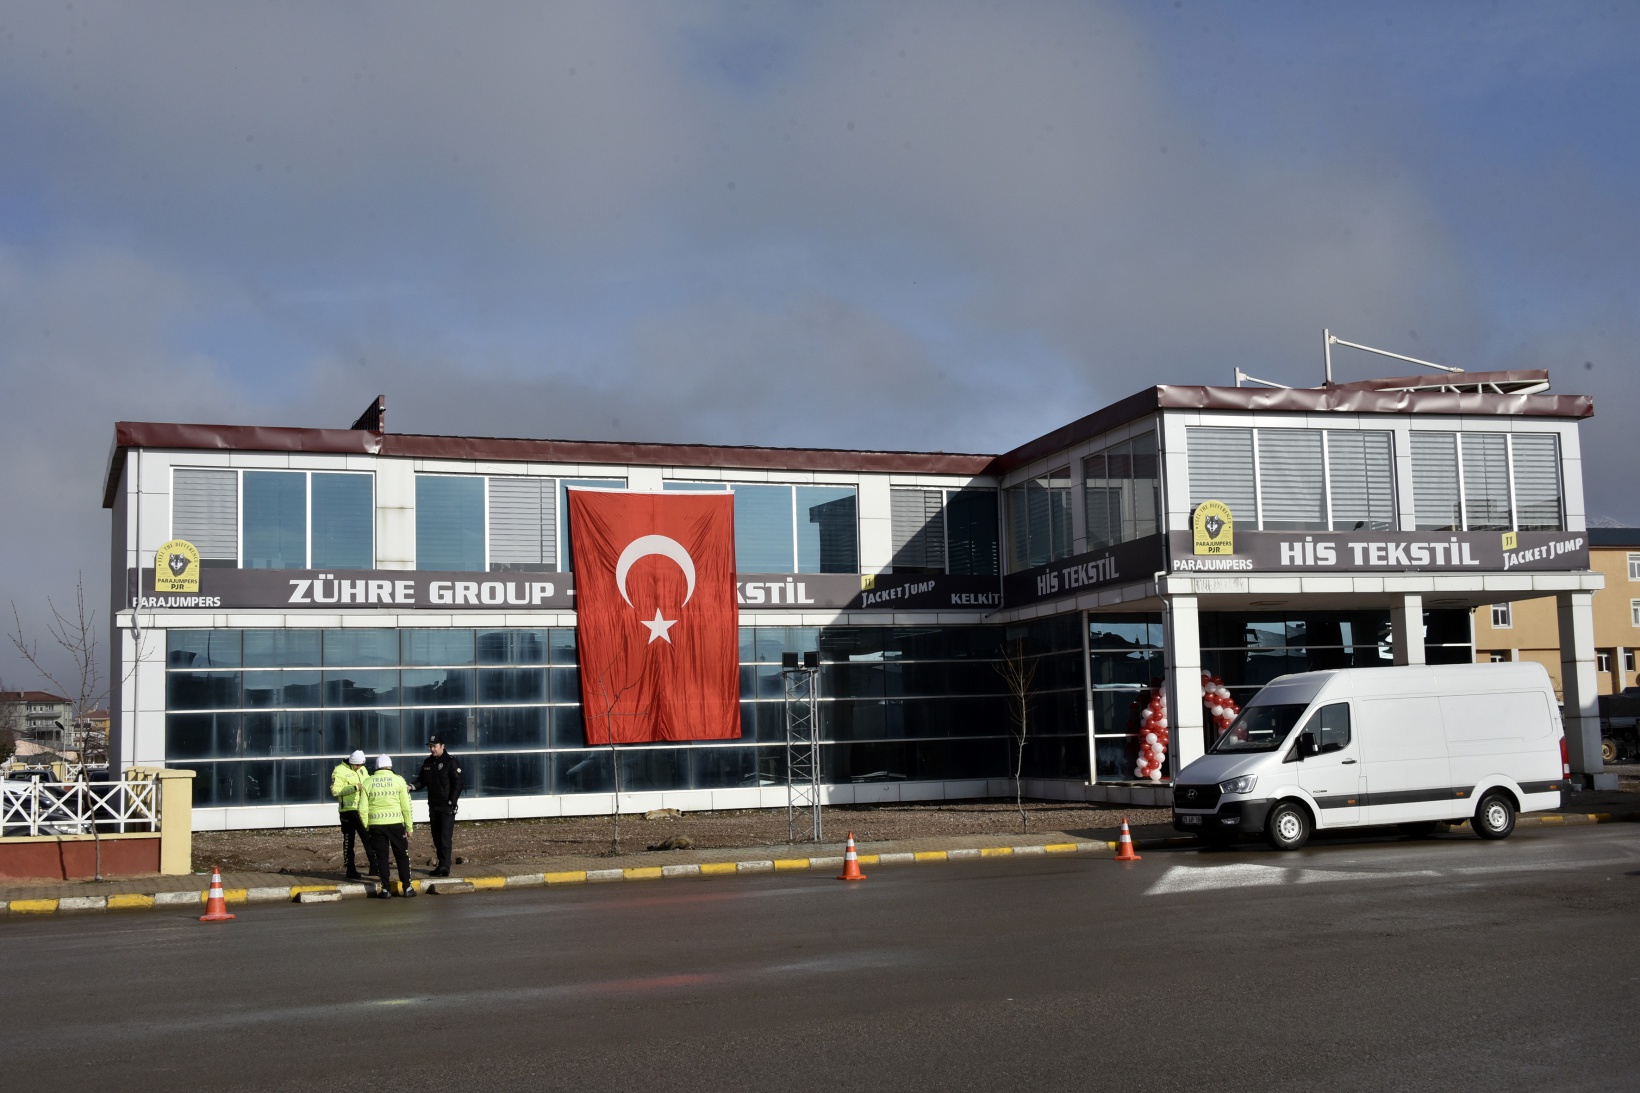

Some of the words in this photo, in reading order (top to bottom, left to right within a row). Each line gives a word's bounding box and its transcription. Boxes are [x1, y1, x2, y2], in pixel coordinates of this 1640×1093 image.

[1173, 559, 1253, 570] PARAJUMPERS
[1280, 536, 1337, 566] HİS
[1348, 536, 1480, 566] TEKSTİL
[1503, 546, 1548, 571] JACKET
[1549, 538, 1584, 560] JUMP
[1037, 568, 1059, 596] HİS
[1062, 552, 1120, 590] TEKSTİL
[132, 596, 221, 608] PARAJUMPERS
[288, 573, 416, 604] ZÜHRE
[429, 580, 555, 605] GROUP
[861, 587, 903, 609] JACKET
[904, 580, 936, 599] JUMP
[951, 592, 1001, 605] KELKİT
